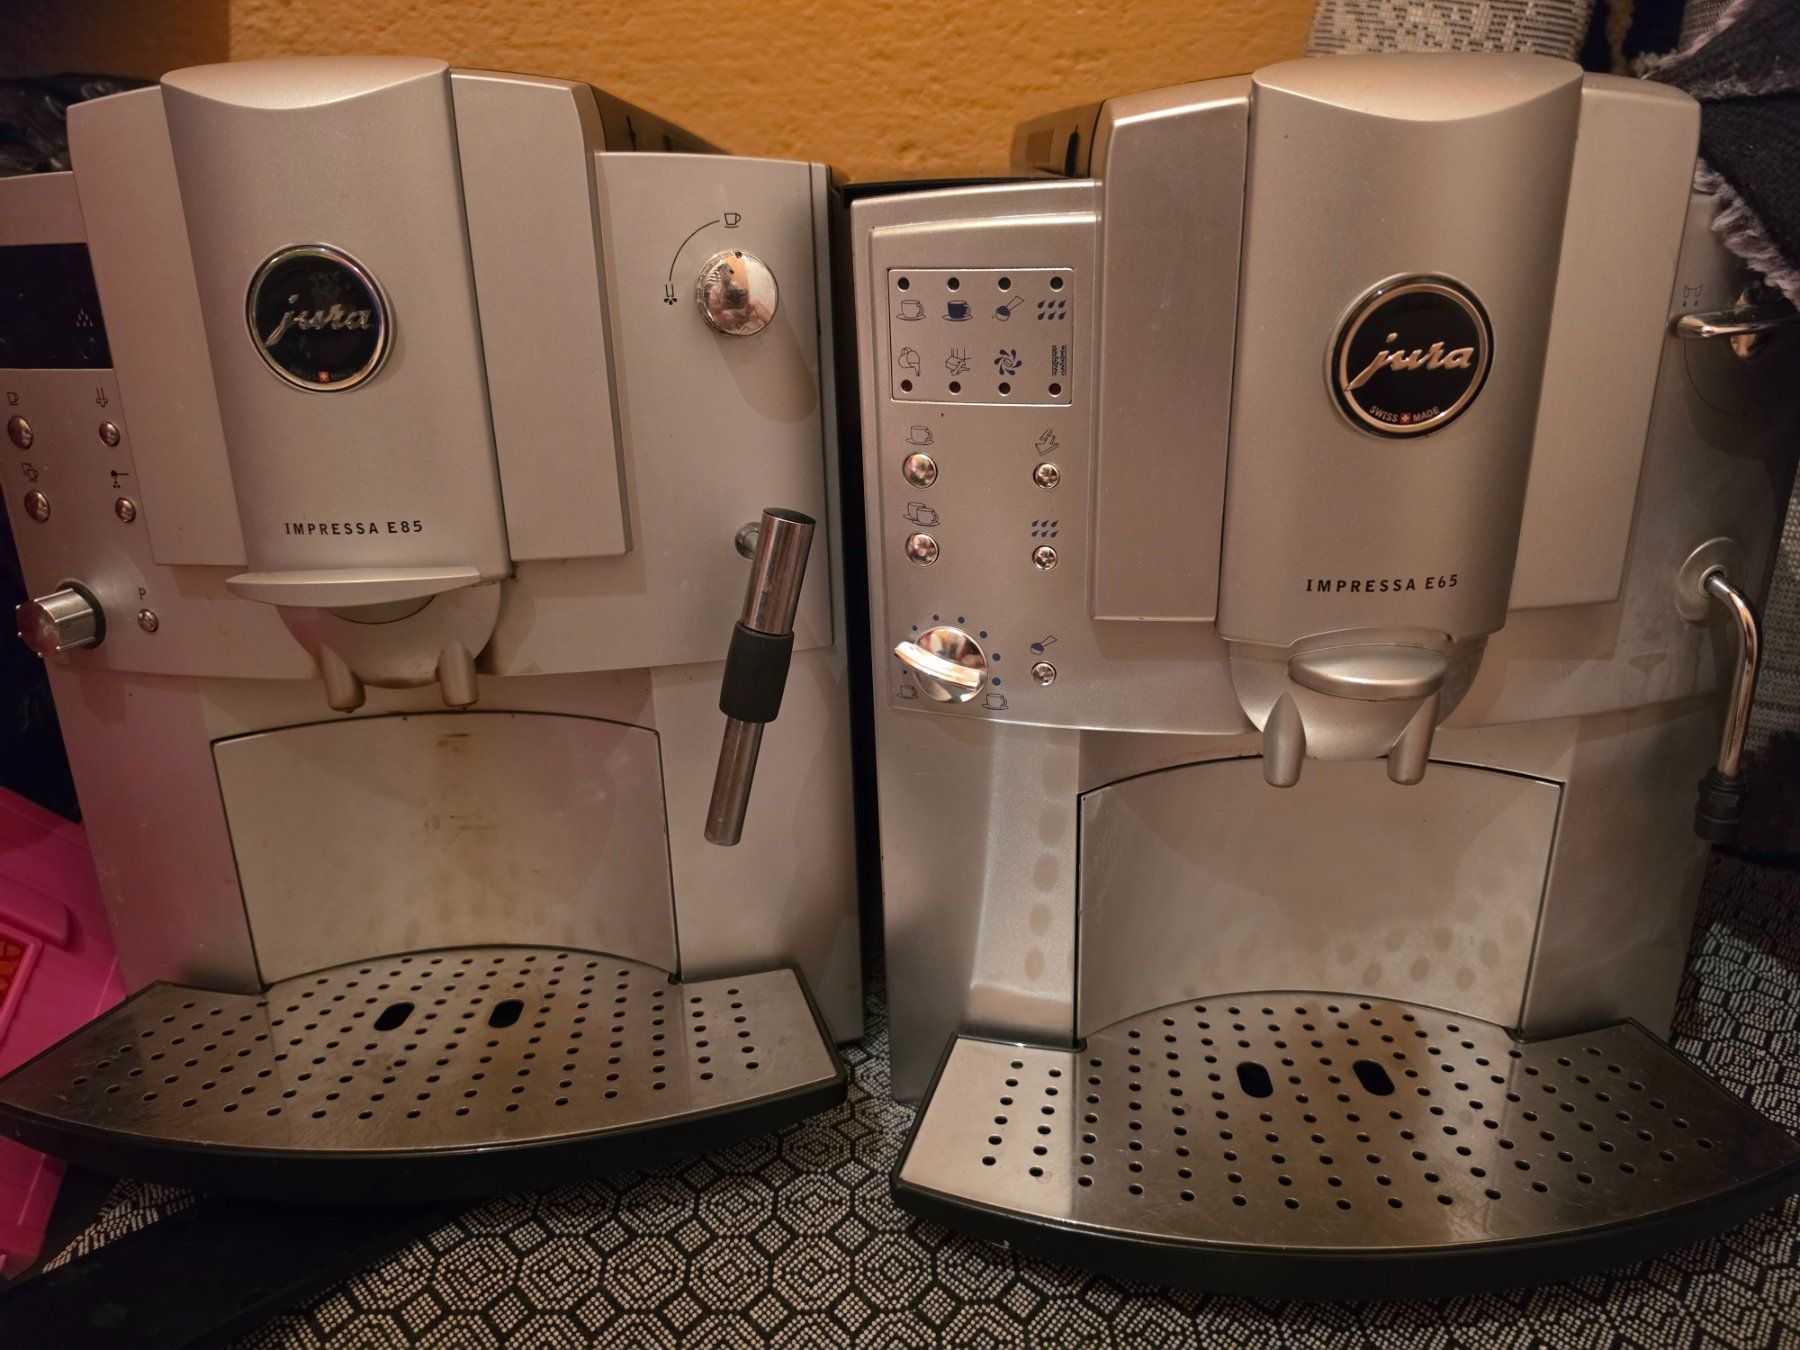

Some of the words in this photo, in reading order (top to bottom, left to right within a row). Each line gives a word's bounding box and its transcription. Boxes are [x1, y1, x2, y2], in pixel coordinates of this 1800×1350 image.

[265, 294, 372, 348] jura
[1344, 332, 1474, 391] jura
[1369, 405, 1398, 422] SWISS
[1412, 406, 1440, 422] MADE
[284, 522, 379, 535] IMPRESSA
[387, 520, 423, 533] E85
[1306, 578, 1416, 593] IMPRESSA
[1425, 574, 1458, 589] E65
